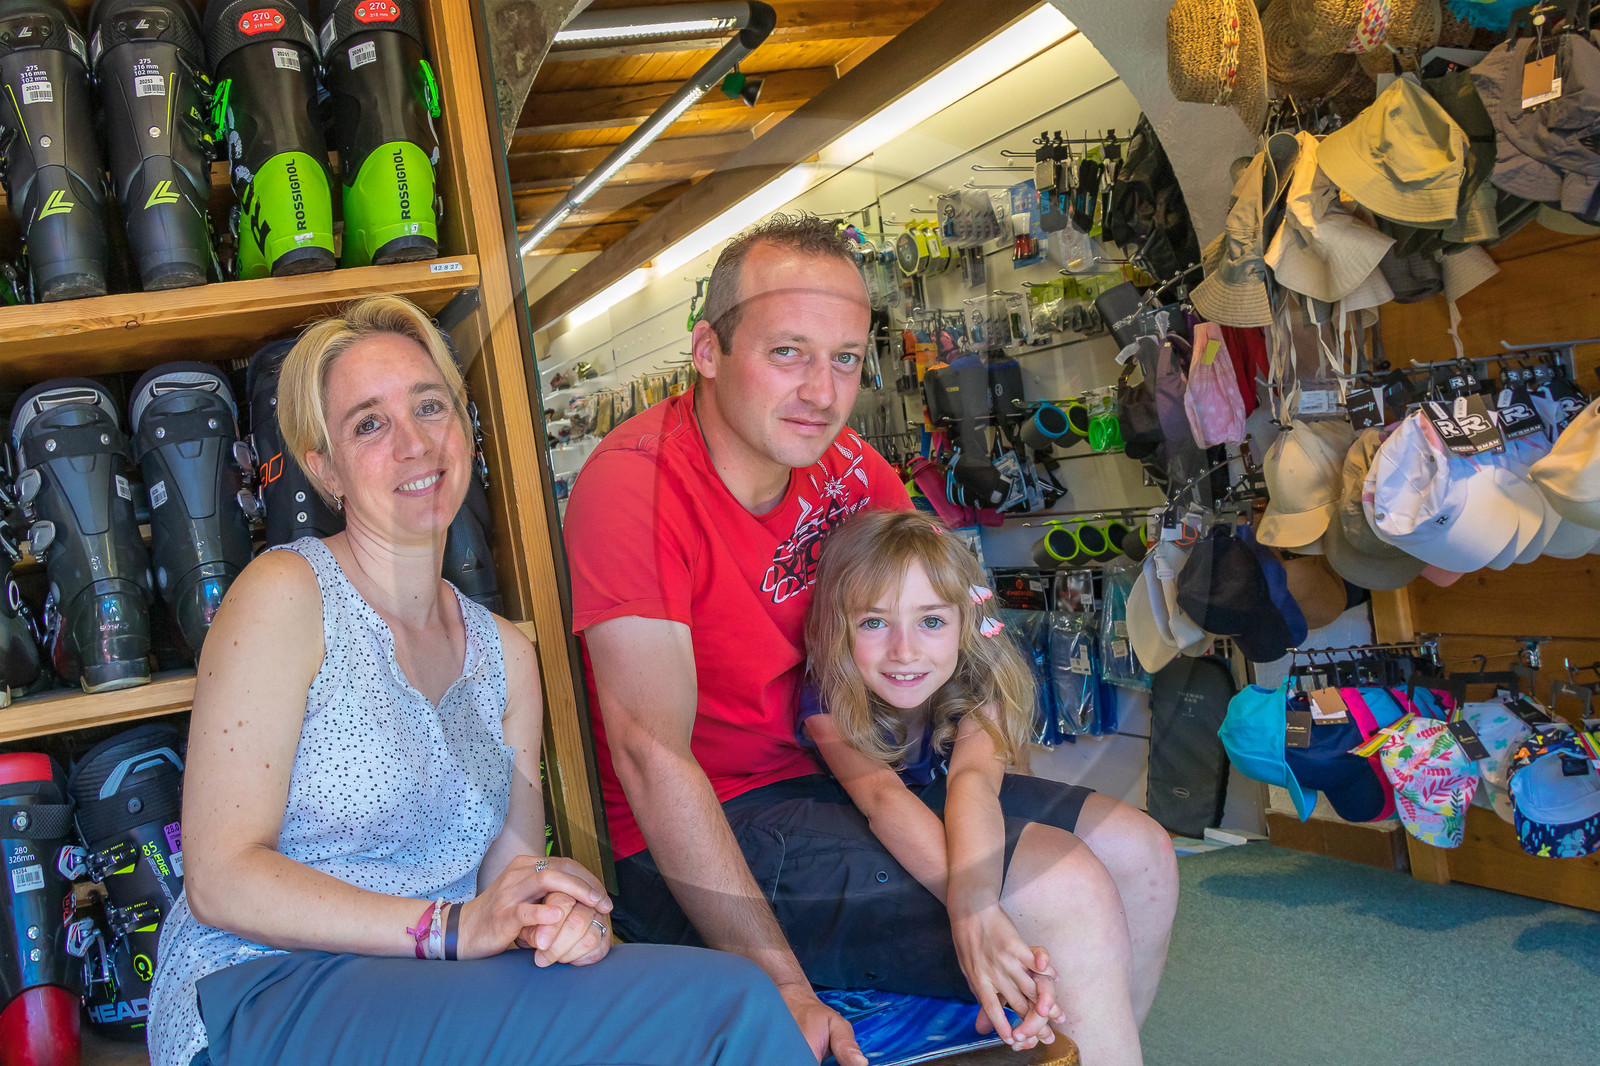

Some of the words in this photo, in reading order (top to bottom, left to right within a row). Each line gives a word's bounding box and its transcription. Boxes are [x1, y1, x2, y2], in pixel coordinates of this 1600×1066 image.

[369, 2, 387, 11] 270
[252, 12, 270, 21] 270
[393, 148, 411, 220] ROSSIGNOL
[286, 158, 307, 231] ROSSIGNOL
[165, 823, 180, 835] 28.0
[14, 846, 28, 855] 280
[142, 841, 157, 856] 85
[9, 854, 35, 864] 326mm
[154, 853, 170, 876] EDGE
[88, 997, 149, 1023] HEAD
